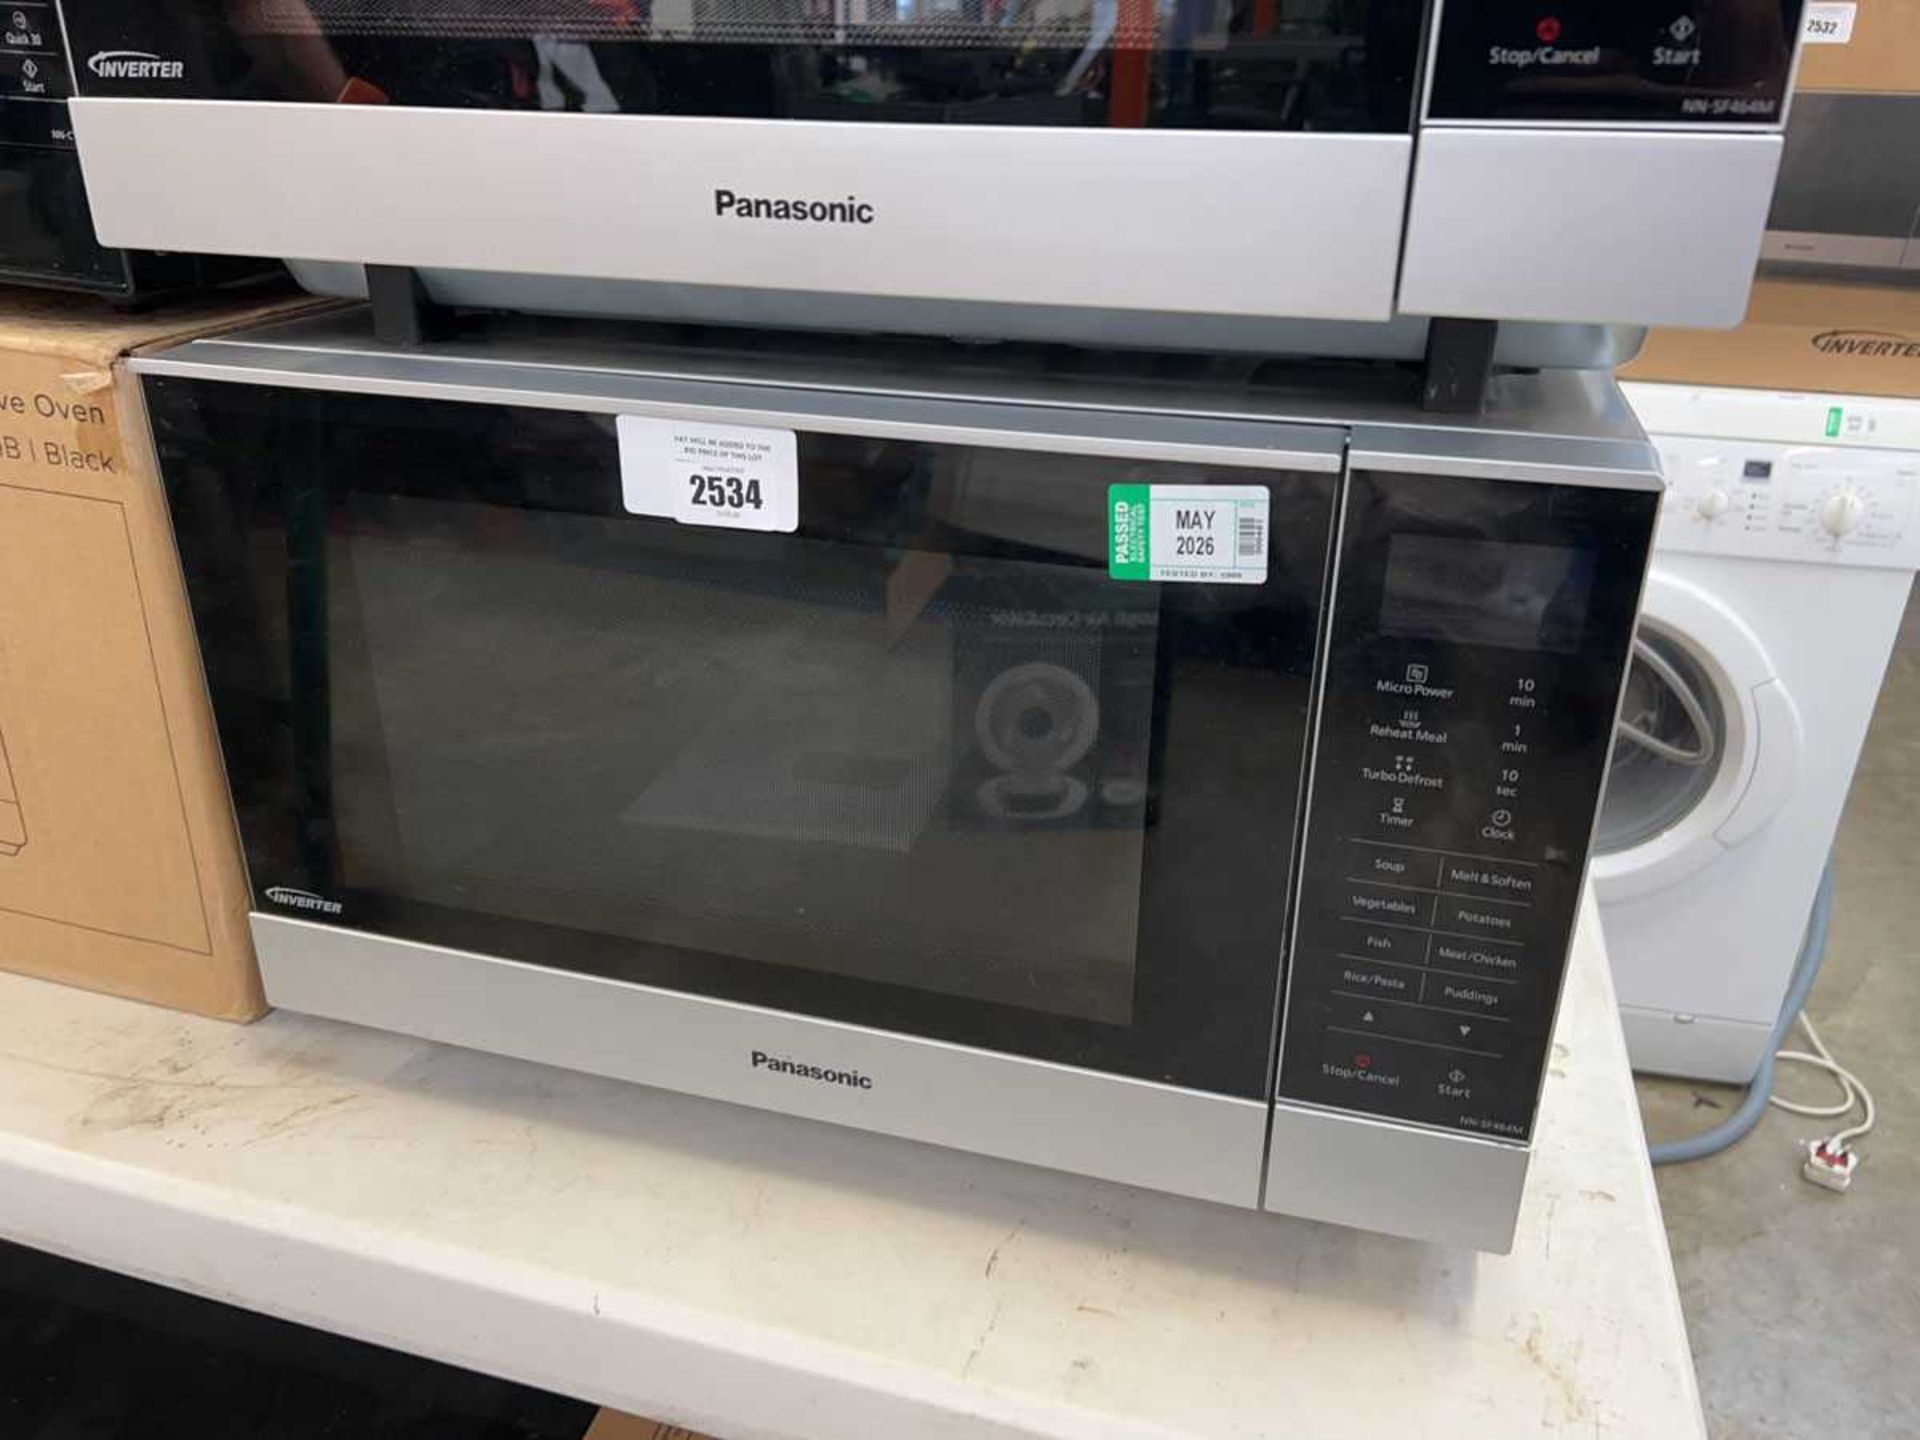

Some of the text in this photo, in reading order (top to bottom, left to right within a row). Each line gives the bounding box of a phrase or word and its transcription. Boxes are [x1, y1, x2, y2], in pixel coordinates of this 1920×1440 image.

[1807, 20, 1837, 34] 2532
[1489, 46, 1600, 68] Stop/Cancel
[1653, 47, 1700, 65] Start
[98, 58, 183, 78] INVERTER
[715, 189, 874, 225] Panasonic
[34, 394, 105, 424] Oven
[0, 436, 21, 460] B
[44, 442, 117, 474] Black
[690, 474, 763, 510] 2534
[1176, 510, 1216, 530] MAY
[1115, 501, 1128, 564] PASSED
[1176, 536, 1215, 556] 2026
[1376, 679, 1454, 700] Micro Power
[1518, 678, 1535, 692] 10
[1509, 695, 1536, 708] min
[1370, 724, 1448, 744] Reheat Meal
[1513, 724, 1521, 736] 1
[1502, 740, 1528, 753] min
[1362, 767, 1444, 788] Turbo Defrost
[1501, 768, 1519, 782] 10
[1496, 785, 1518, 797] sec
[1379, 812, 1414, 827] Timer
[1482, 826, 1515, 841] Clock
[1374, 858, 1405, 873] Soup
[1451, 869, 1532, 891] Melt & Soften
[272, 891, 343, 914] INVERTER
[1352, 895, 1416, 915] Vegetables
[1457, 910, 1511, 928] Potatoes
[1366, 935, 1392, 948] Fish
[1439, 946, 1517, 968] Meat/Chicken
[1344, 970, 1406, 990] Rice/Pasta
[1444, 986, 1499, 1005] Puddings
[751, 1050, 872, 1089] Panasonic
[1321, 1063, 1400, 1087] Stop/Cancel
[1437, 1083, 1471, 1099] Start
